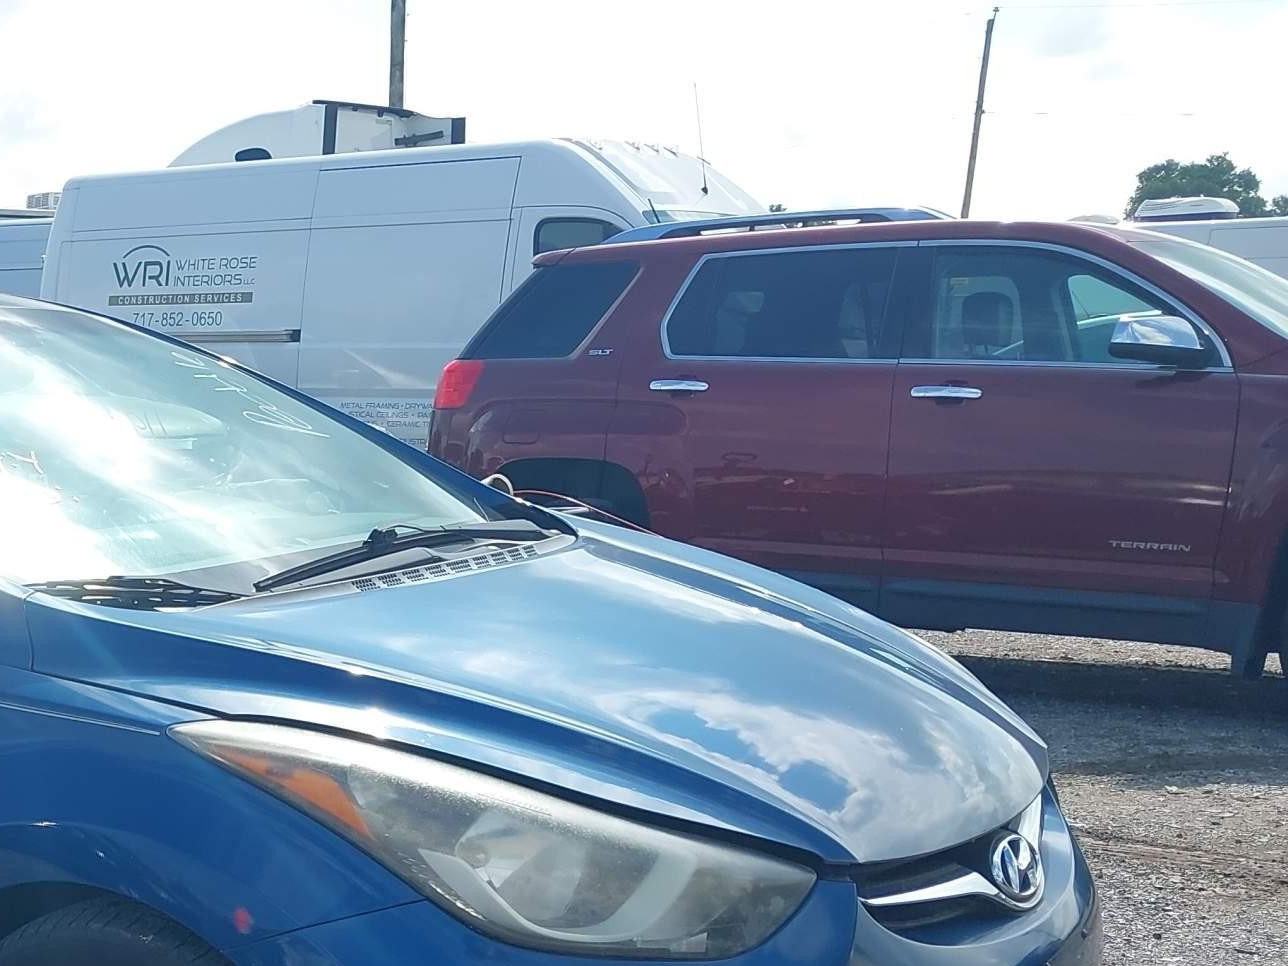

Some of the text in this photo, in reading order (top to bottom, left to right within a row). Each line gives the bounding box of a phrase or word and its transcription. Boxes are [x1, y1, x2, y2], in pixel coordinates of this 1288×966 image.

[175, 256, 258, 271] WHITE ROSE
[113, 260, 171, 288] WRI
[173, 273, 256, 287] INTERIORS LLC
[118, 292, 243, 305] CONSTRUCTION SERVICES
[132, 311, 223, 327] 717-852-0650
[588, 348, 614, 356] SLT
[366, 402, 400, 410] FRAMING
[1108, 539, 1191, 552] TERRAIN
